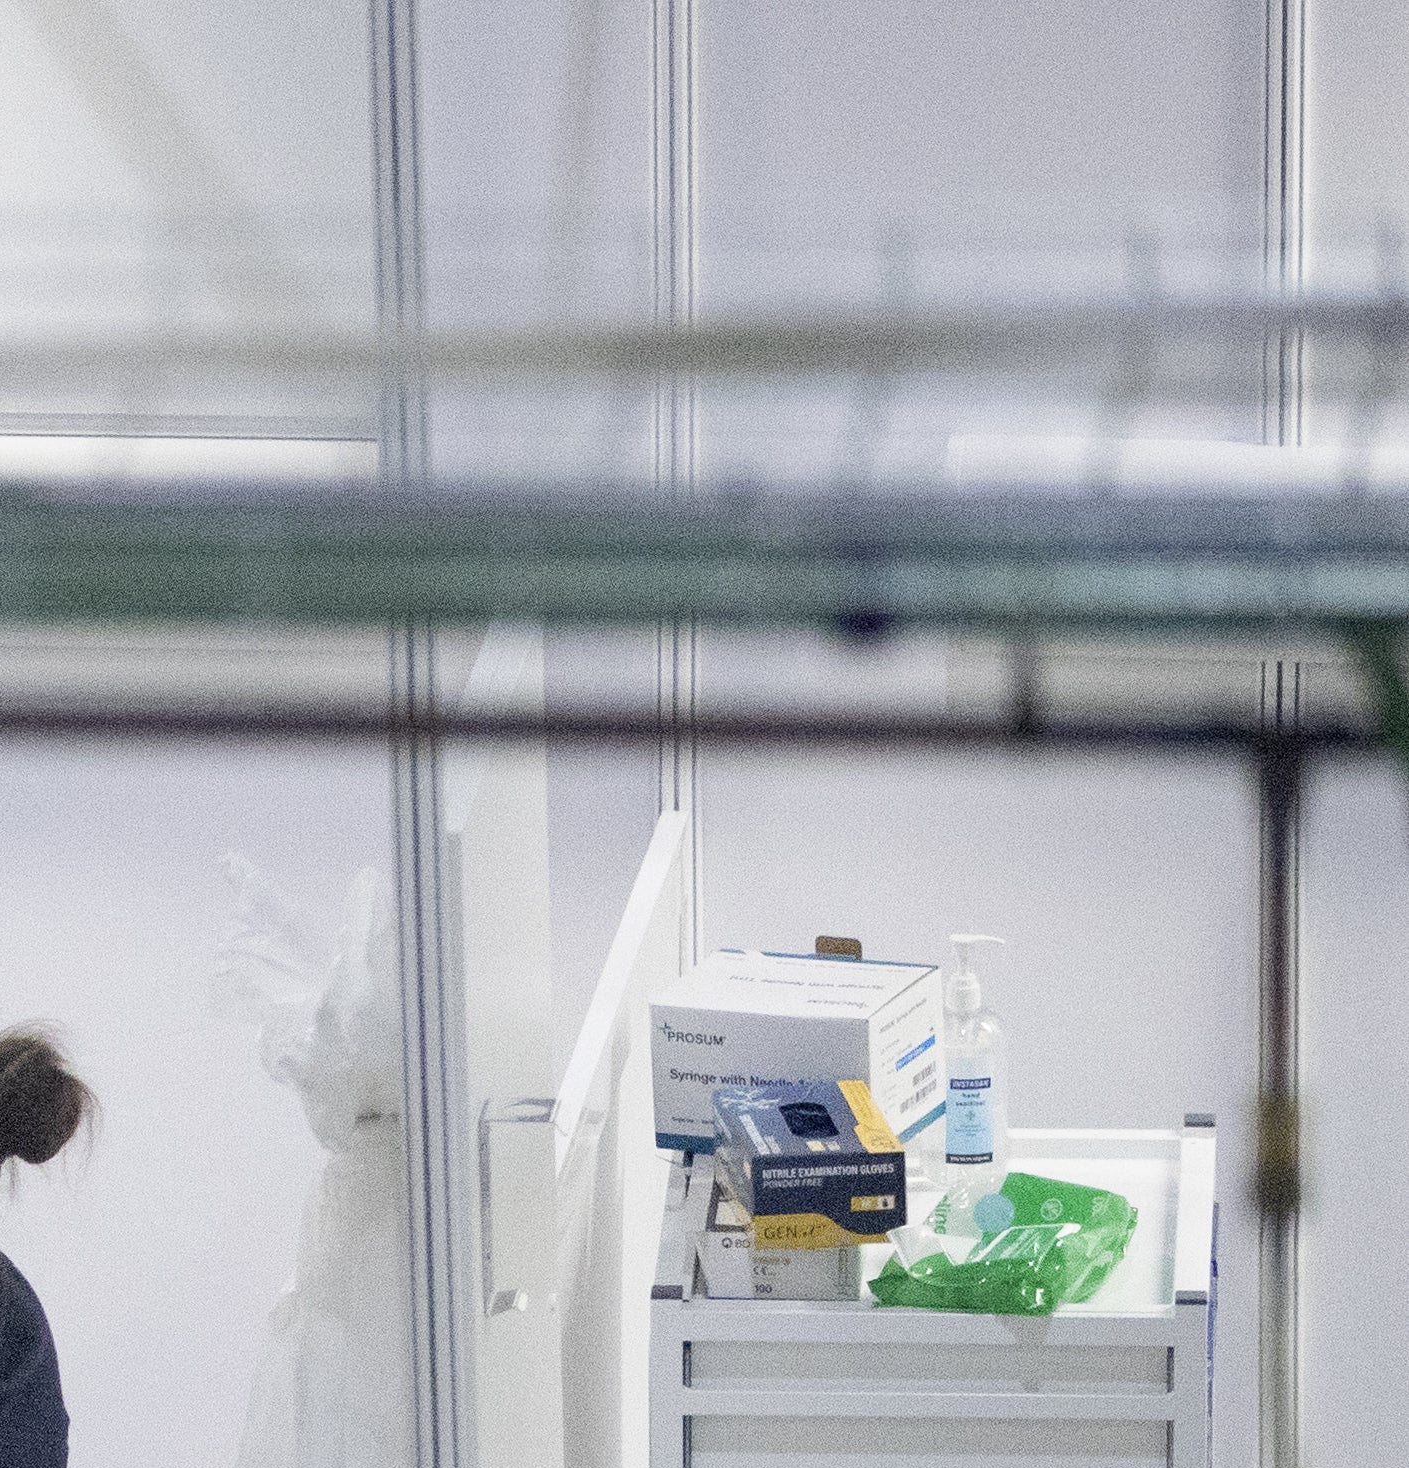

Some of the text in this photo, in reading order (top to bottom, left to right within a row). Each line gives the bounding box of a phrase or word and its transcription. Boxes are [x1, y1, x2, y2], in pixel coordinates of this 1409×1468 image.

[669, 1068, 717, 1085] Syringe
[719, 1074, 747, 1086] with
[762, 1163, 895, 1180] NITRILE EXAMINATION GLOVES
[763, 1178, 823, 1189] POWDER FREE
